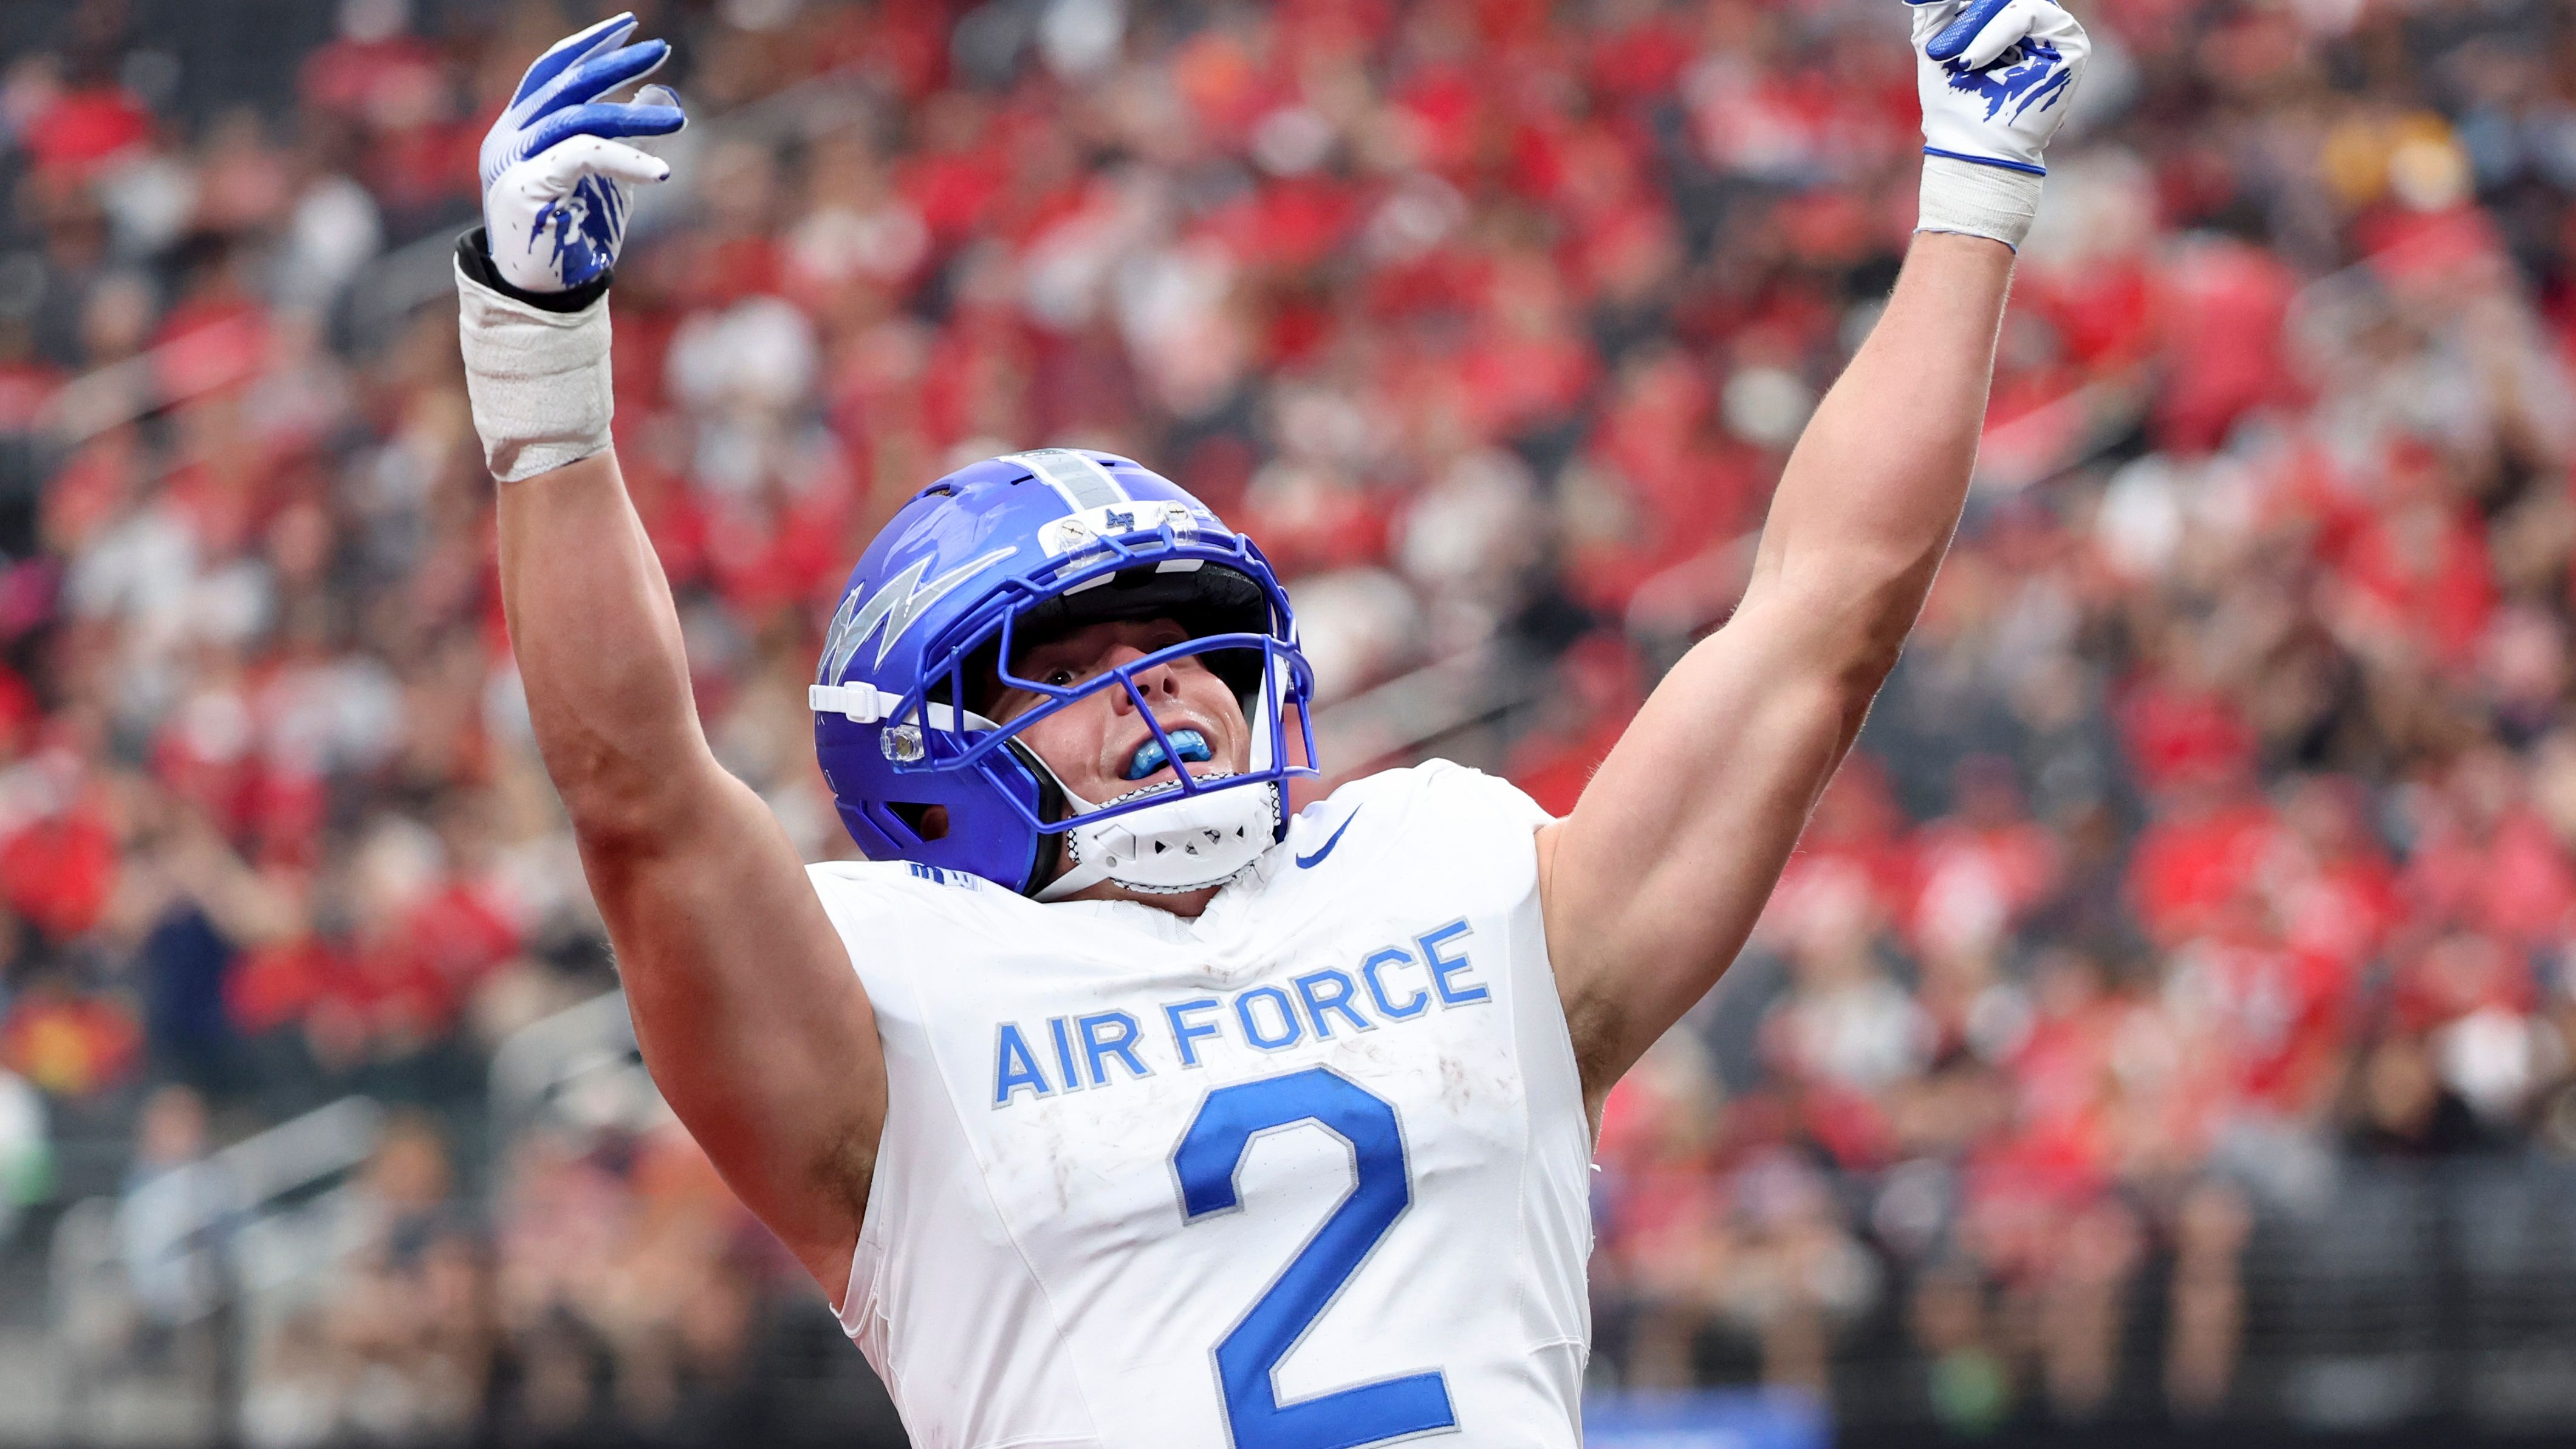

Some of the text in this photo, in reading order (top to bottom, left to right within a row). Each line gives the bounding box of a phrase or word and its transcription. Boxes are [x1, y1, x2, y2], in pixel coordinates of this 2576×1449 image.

[1105, 508, 1135, 532] AF
[992, 916, 1491, 1109] AIR FORCE
[1166, 1062, 1462, 1449] 2
